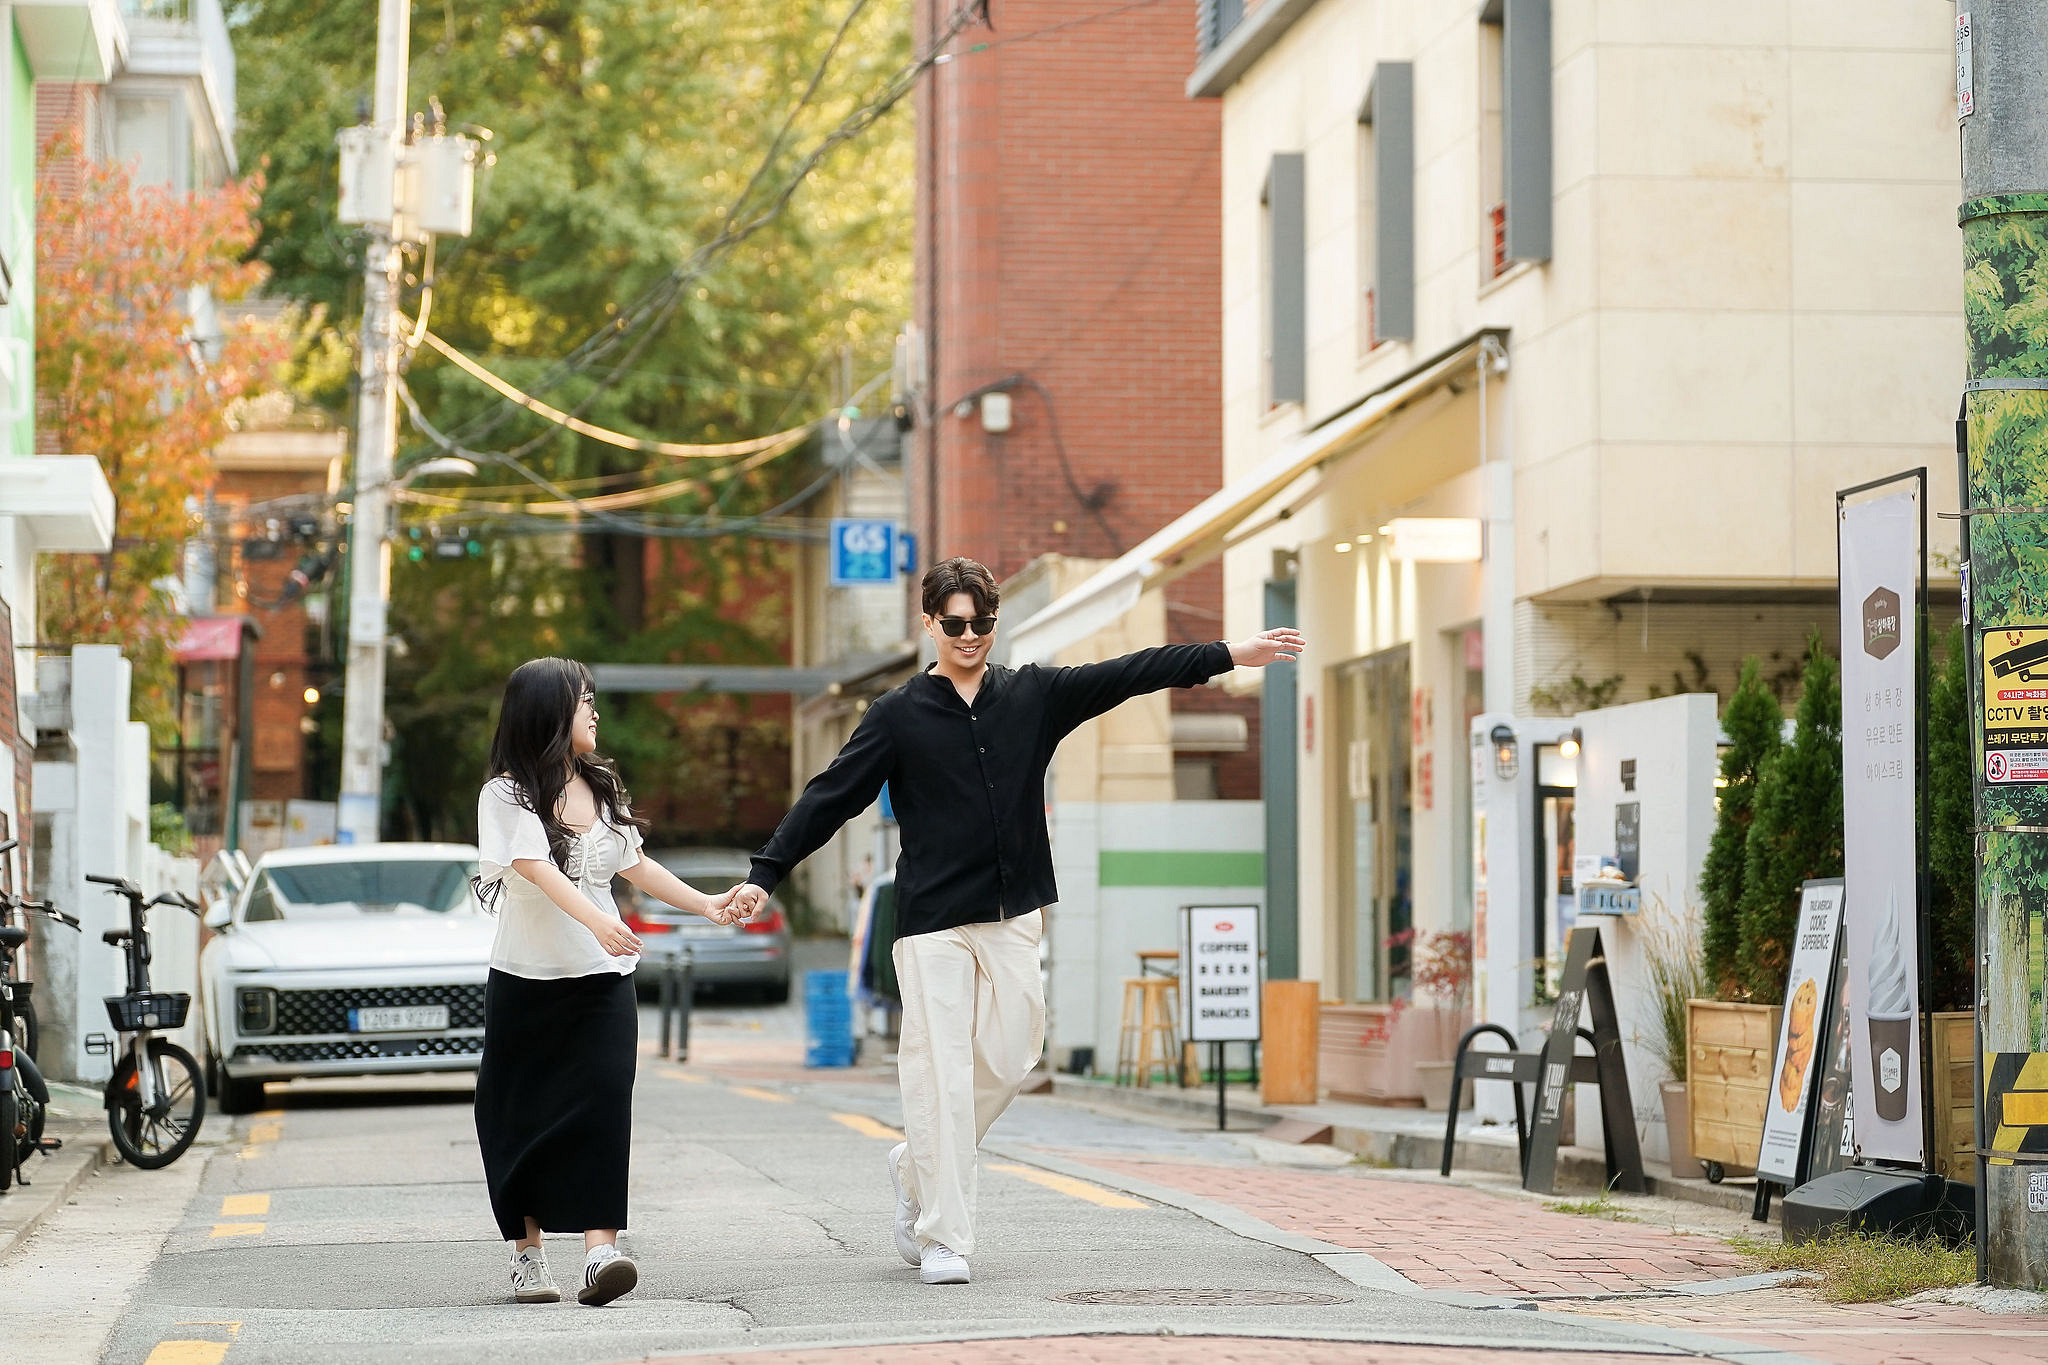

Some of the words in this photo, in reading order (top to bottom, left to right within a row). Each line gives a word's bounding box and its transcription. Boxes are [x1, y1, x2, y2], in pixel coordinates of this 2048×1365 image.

[843, 524, 887, 553] GS
[2003, 691, 2024, 699] 24시간
[1987, 706, 2024, 721] CCTV
[1987, 733, 2009, 744] 쓰레기
[1866, 759, 1903, 782] 아이스크림
[1809, 914, 1828, 931] COOKIE
[1200, 942, 1249, 953] COFFEE
[1801, 934, 1830, 950] EXPERIENCE
[1201, 986, 1249, 997] BAKERY
[1201, 1008, 1250, 1019] SNACKS
